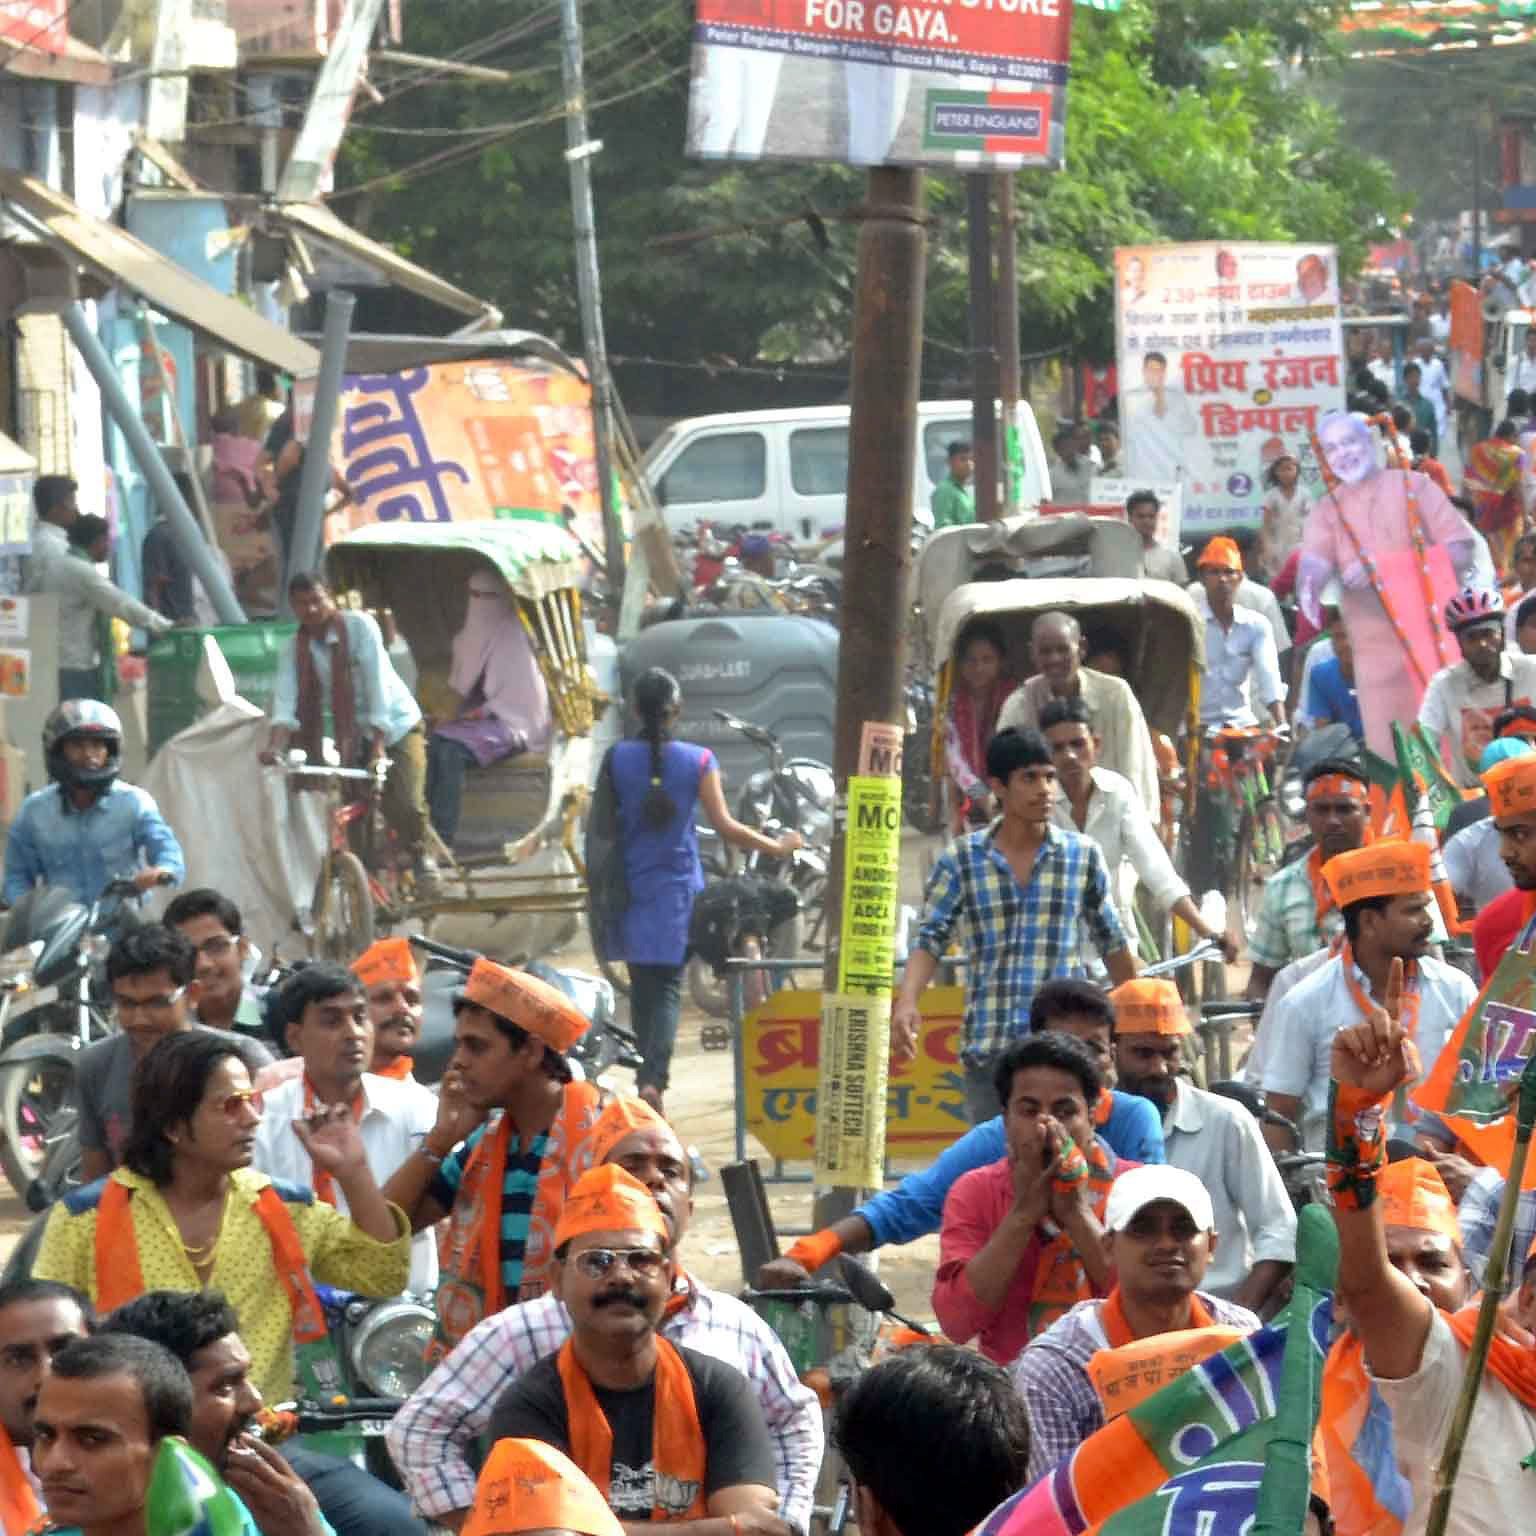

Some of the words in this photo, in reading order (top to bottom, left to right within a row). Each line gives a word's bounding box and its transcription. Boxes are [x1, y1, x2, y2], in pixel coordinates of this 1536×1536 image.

[706, 27, 738, 44] Peter
[804, 1, 865, 32] FOR
[873, 5, 959, 43] GAYA.
[936, 109, 978, 128] PETER
[981, 111, 1040, 131] ENGLAND
[1180, 349, 1248, 395] प्रिय
[1260, 347, 1340, 392] रंजन
[1198, 401, 1319, 440] डिम्पल
[847, 1008, 869, 1072] KRISHNA
